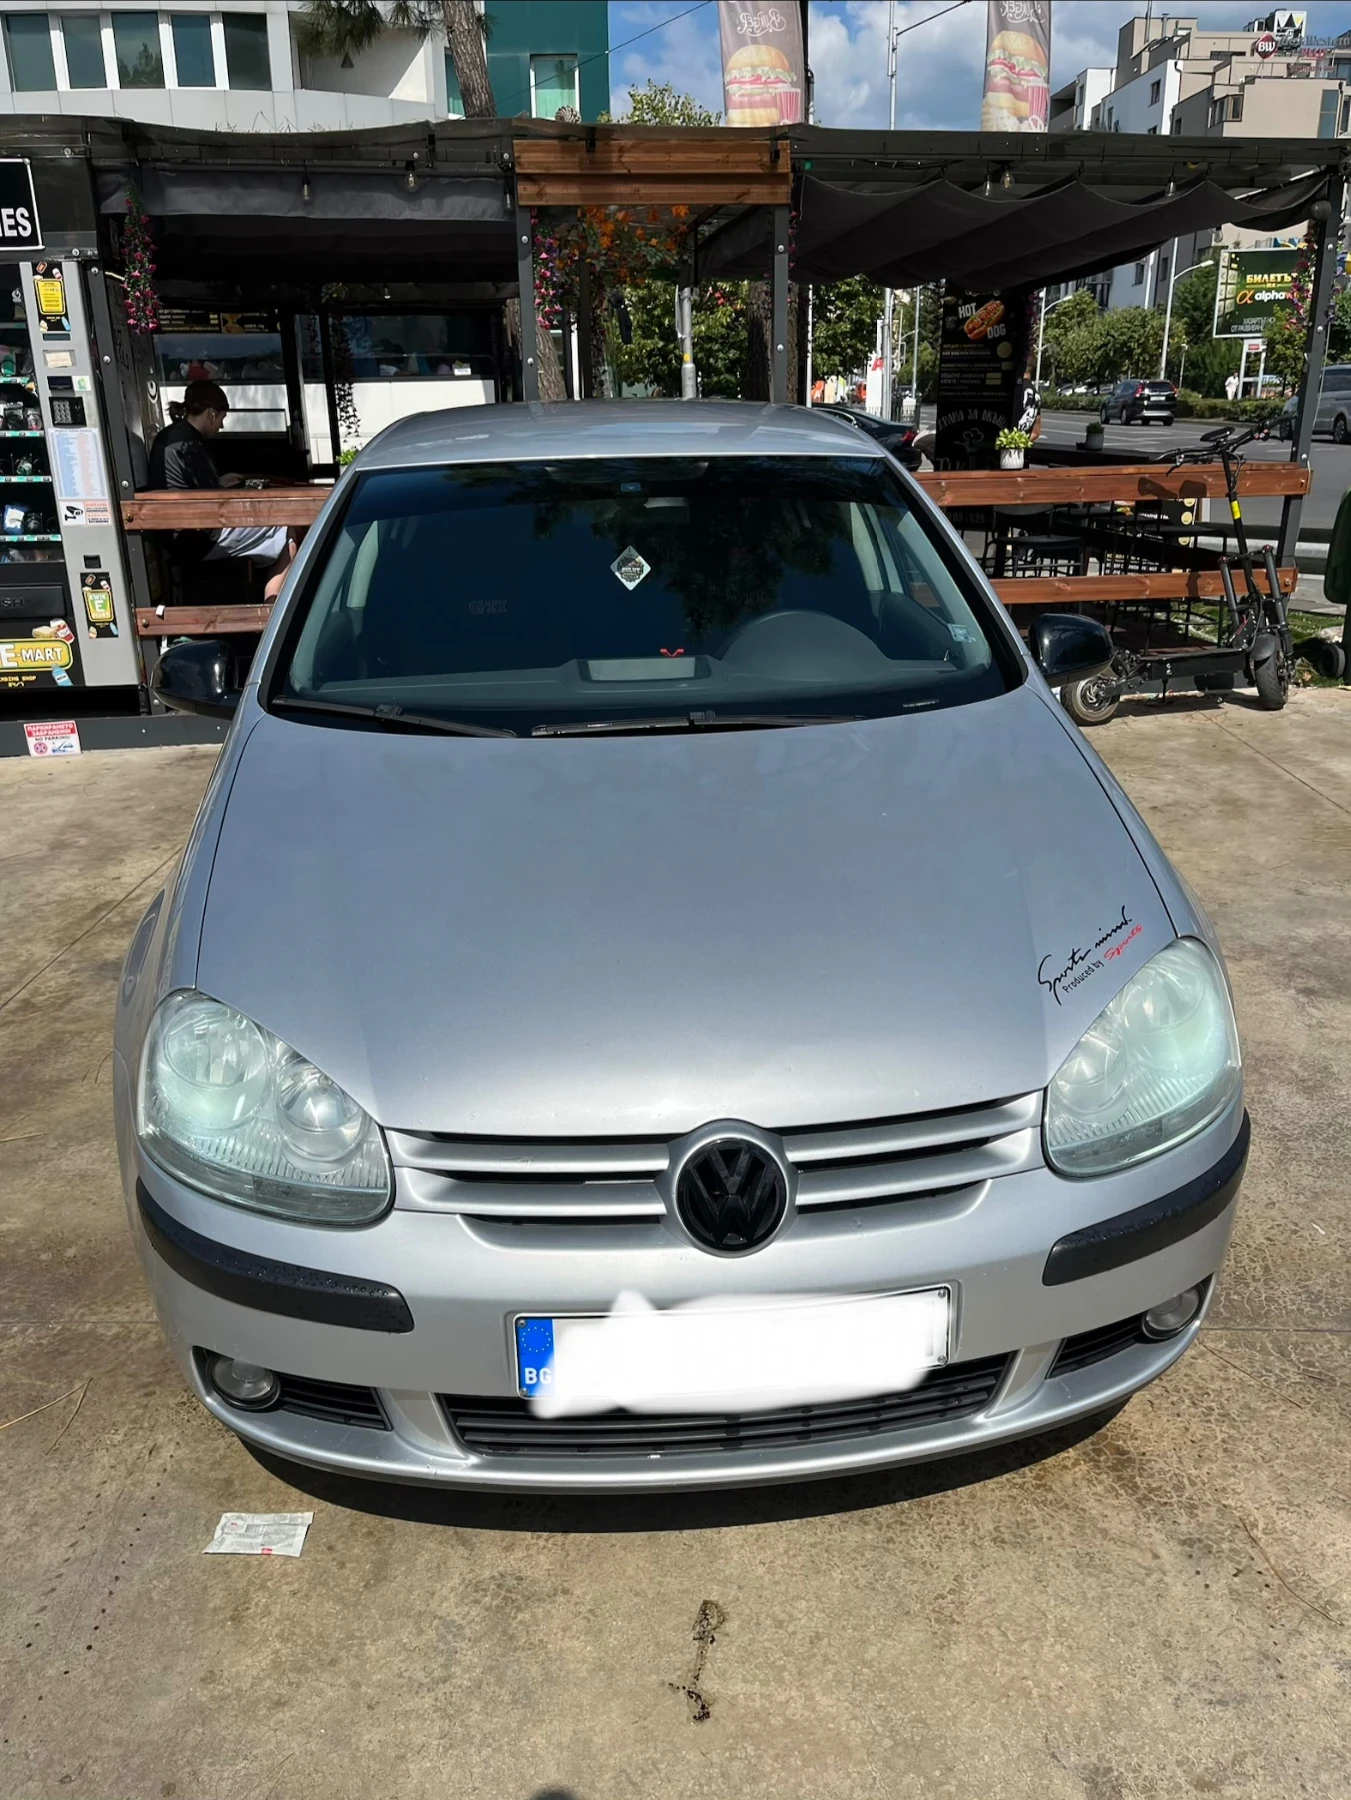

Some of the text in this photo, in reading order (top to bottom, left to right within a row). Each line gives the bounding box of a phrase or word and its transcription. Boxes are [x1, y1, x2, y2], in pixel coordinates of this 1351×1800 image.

[1258, 41, 1275, 52] BW
[0, 207, 32, 237] ES
[958, 302, 976, 319] HOT
[987, 324, 1006, 340] DOG
[94, 599, 105, 613] E
[1062, 965, 1096, 993] Produced
[1092, 960, 1105, 975] by
[524, 1367, 553, 1385] BG
